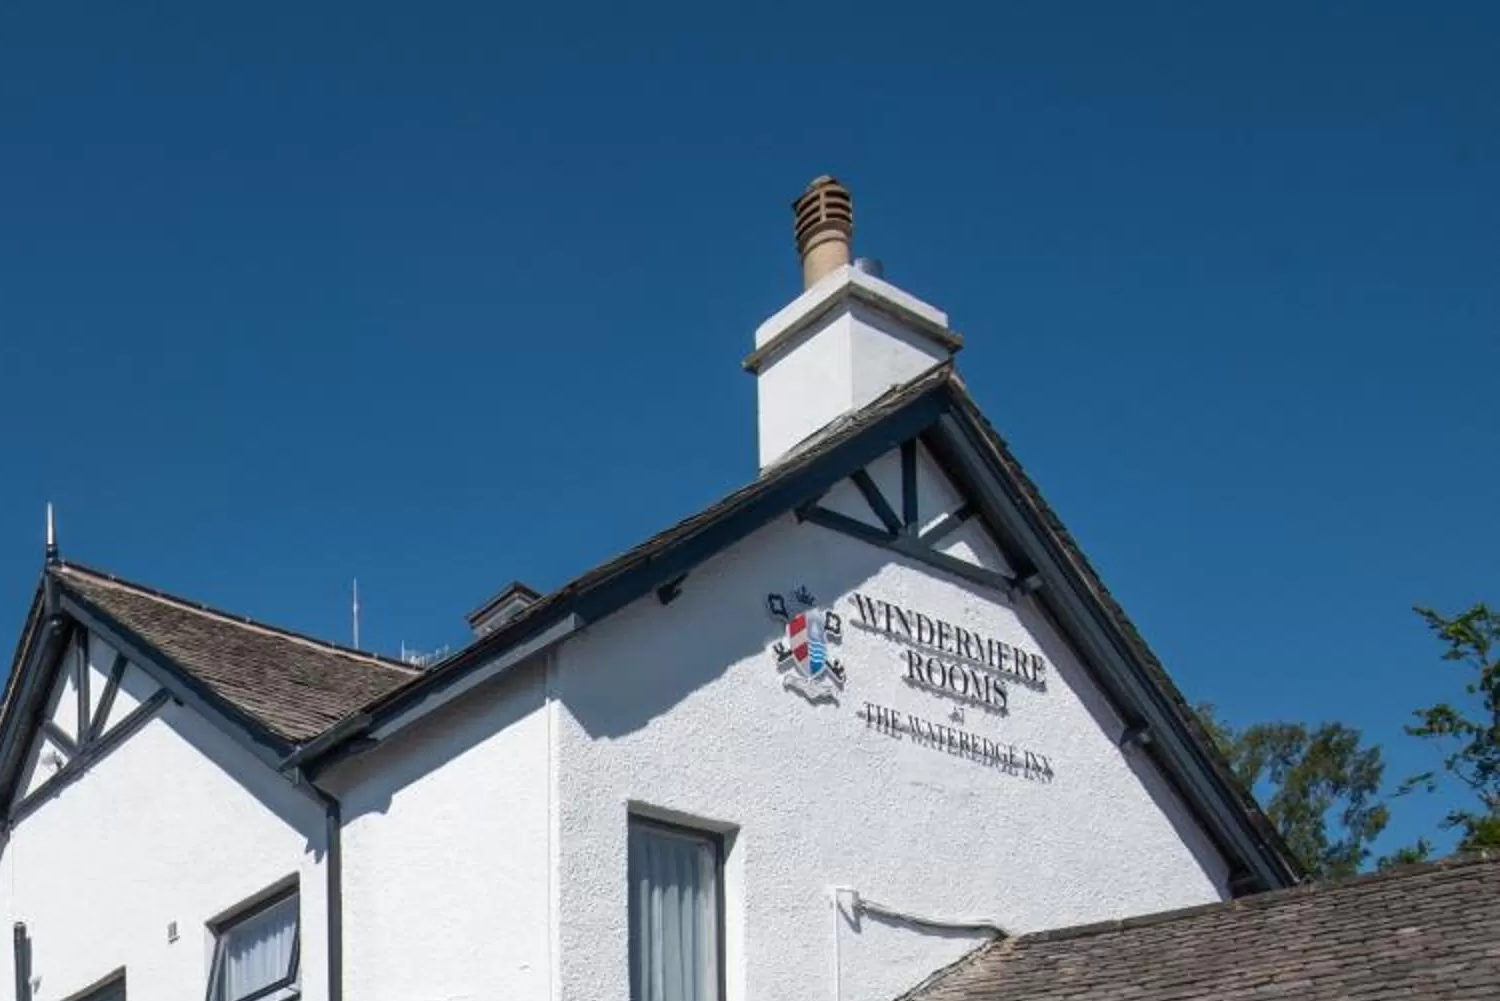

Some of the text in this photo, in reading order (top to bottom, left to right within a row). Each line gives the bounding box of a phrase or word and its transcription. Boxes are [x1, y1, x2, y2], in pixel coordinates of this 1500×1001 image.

[853, 593, 1046, 685] WINDERMERE
[903, 648, 1008, 711] ROOMS
[863, 701, 901, 732] THE
